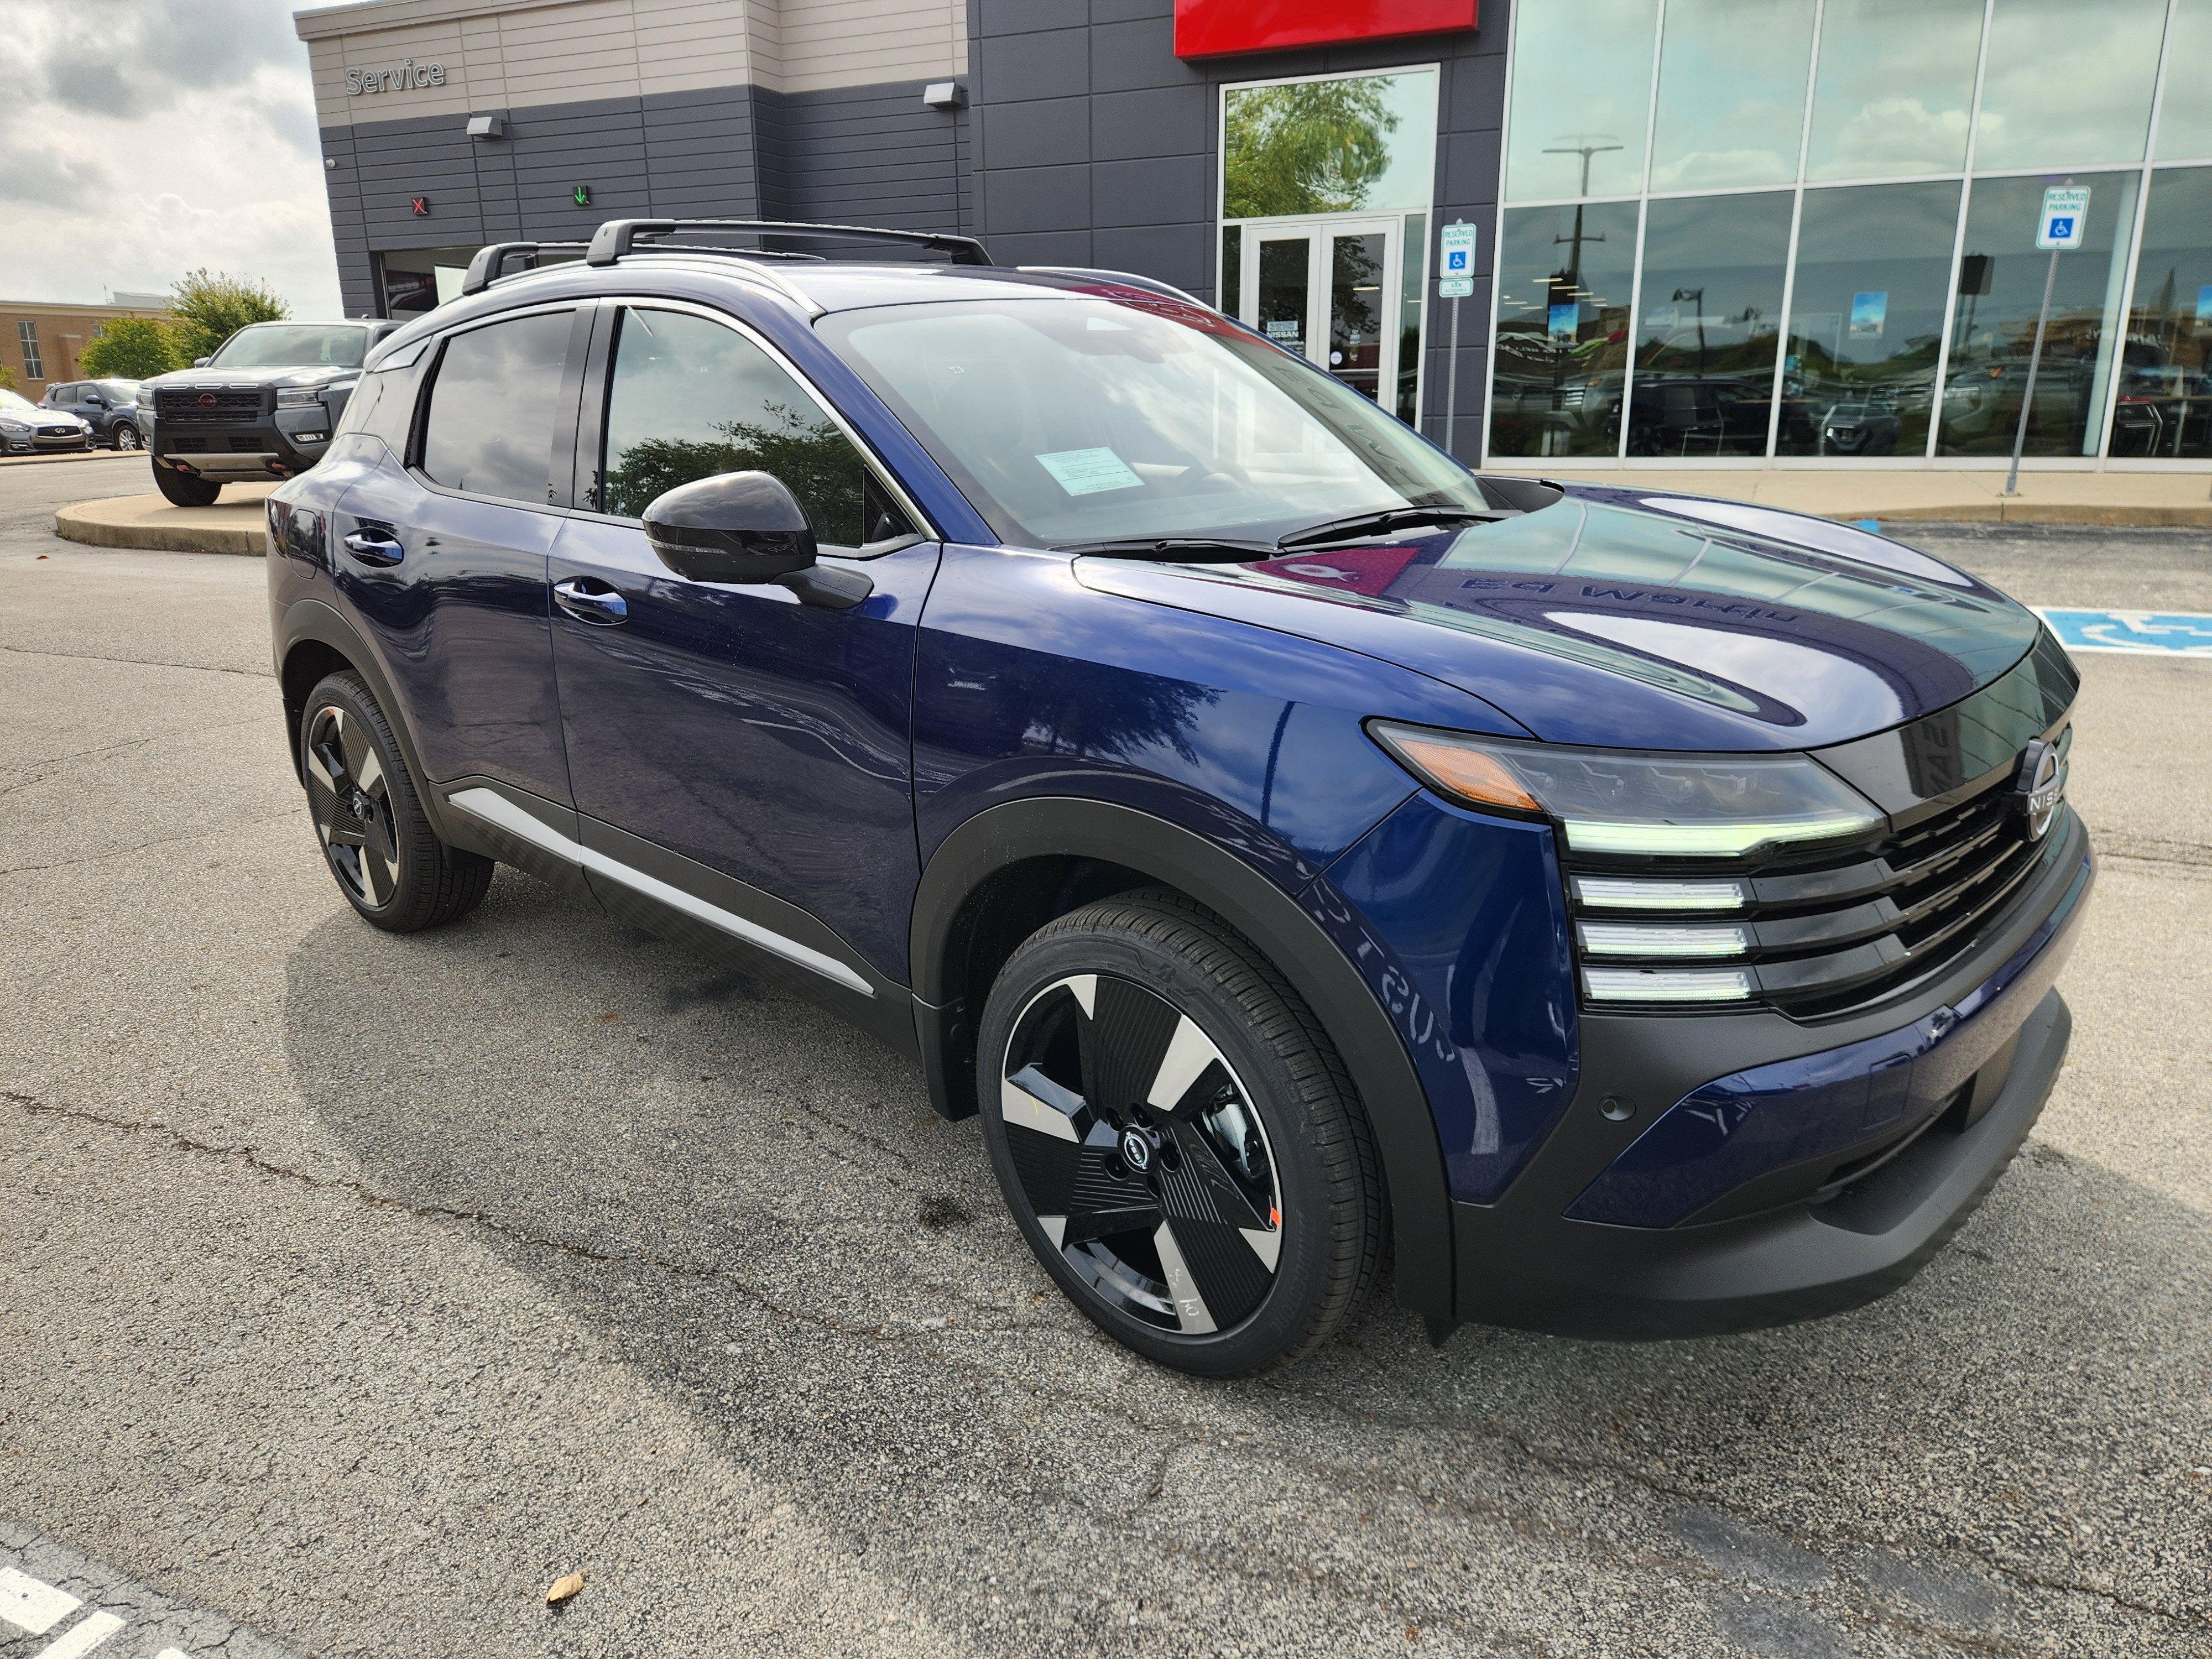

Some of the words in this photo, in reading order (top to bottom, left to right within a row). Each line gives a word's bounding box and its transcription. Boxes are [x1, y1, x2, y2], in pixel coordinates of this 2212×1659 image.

[345, 58, 446, 96] Service
[2047, 192, 2086, 201] RESERVED
[2049, 202, 2081, 211] PARKING
[2030, 788, 2058, 811] NISS
